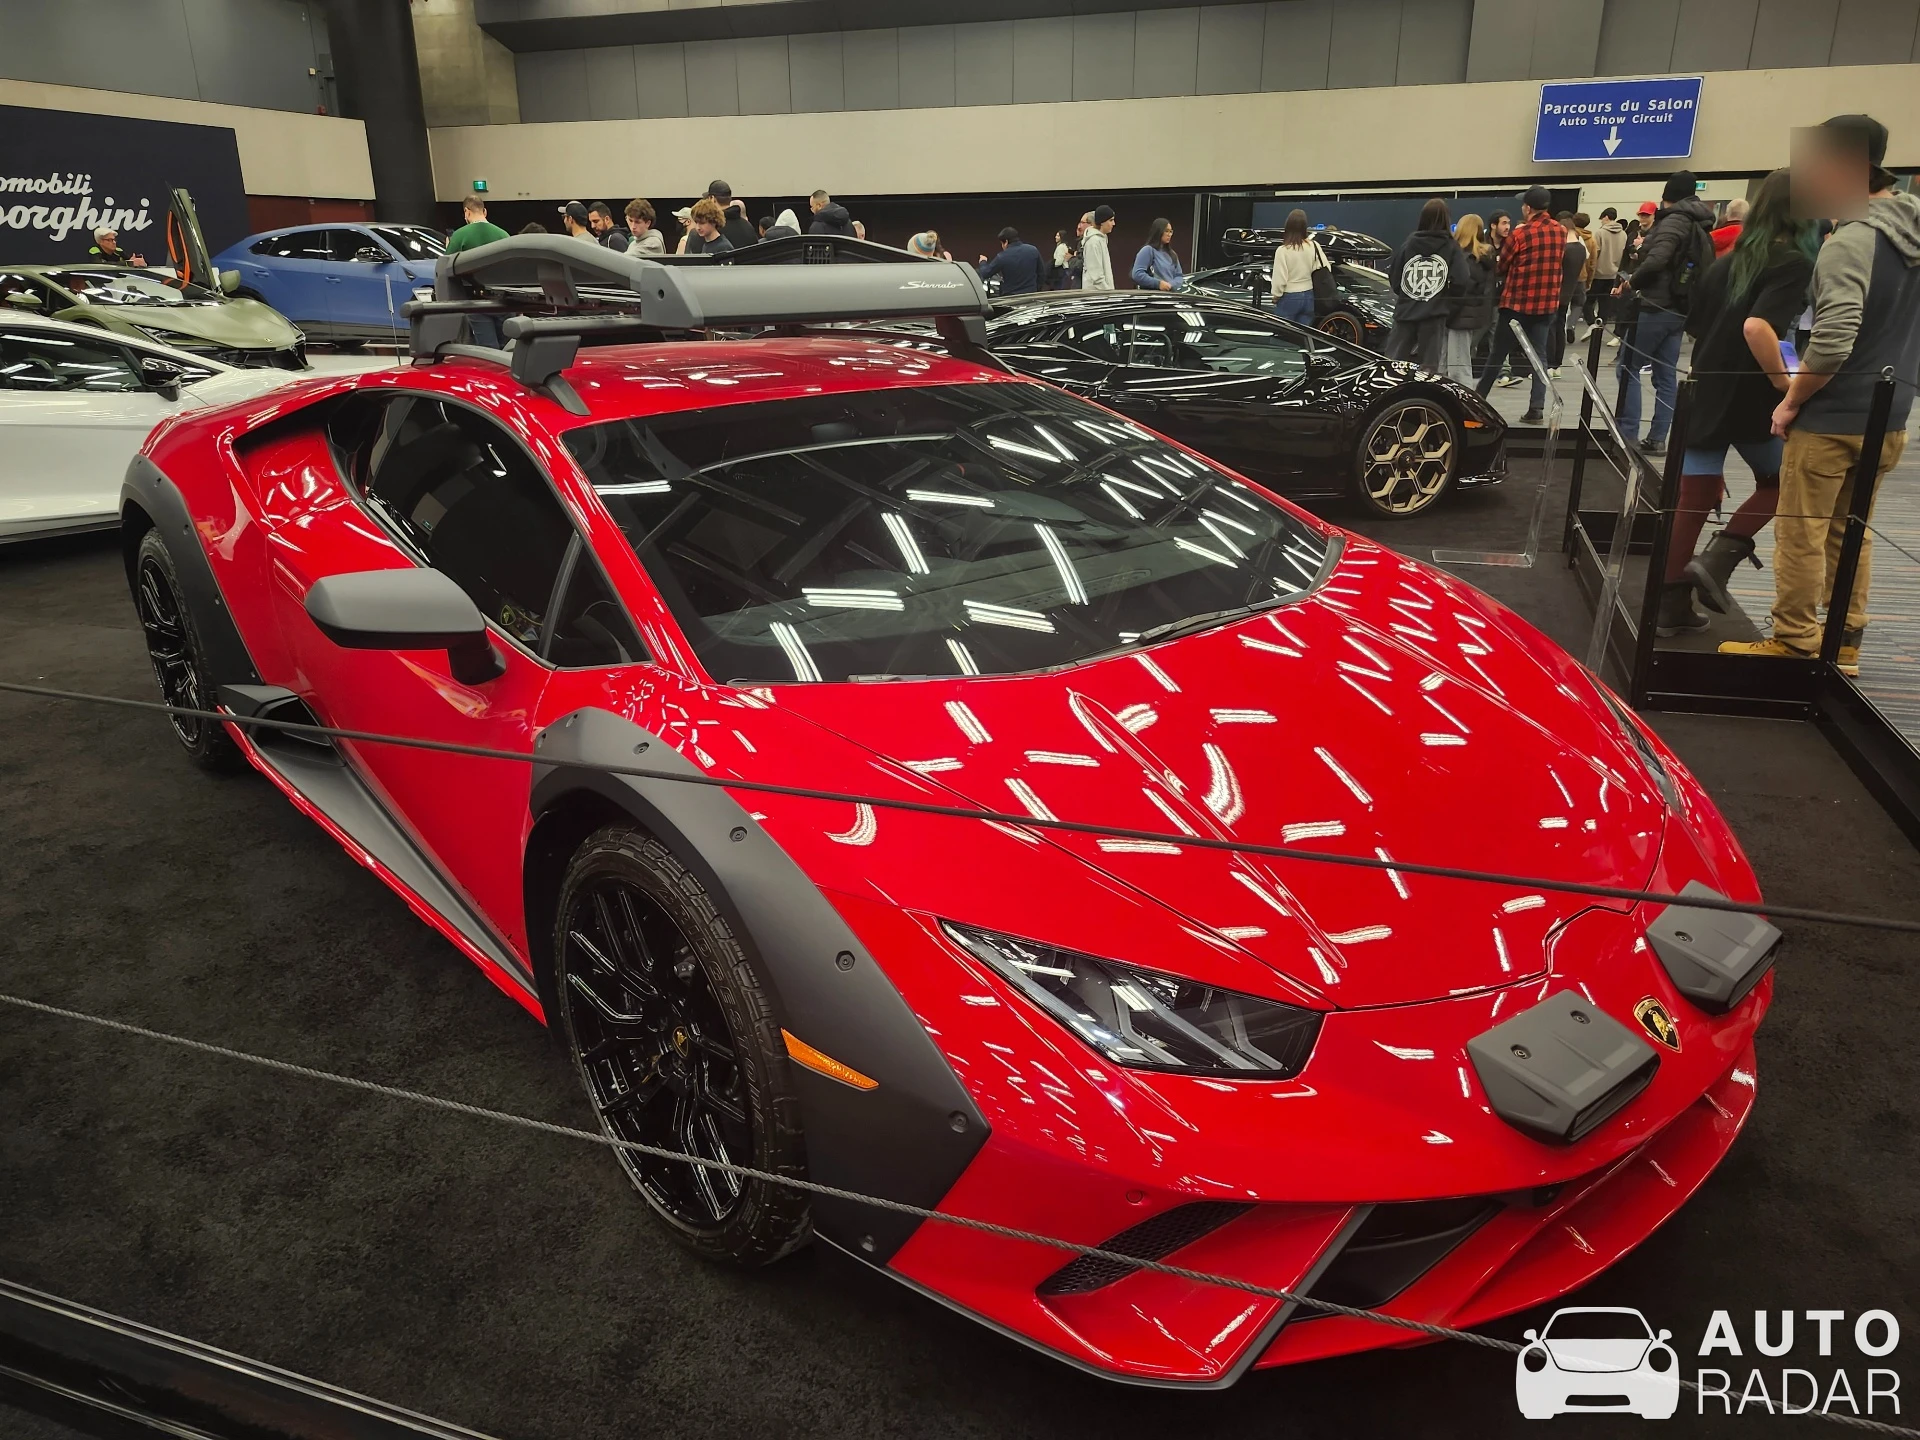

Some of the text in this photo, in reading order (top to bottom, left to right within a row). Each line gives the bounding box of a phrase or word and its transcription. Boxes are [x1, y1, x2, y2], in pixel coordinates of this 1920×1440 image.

[1544, 98, 1693, 115] Parcours du Salon
[1559, 113, 1673, 126] Auto Show Circuit
[0, 196, 153, 242] orghini
[899, 280, 964, 290] Sterrato
[656, 882, 766, 1136] BRIDGESTONE
